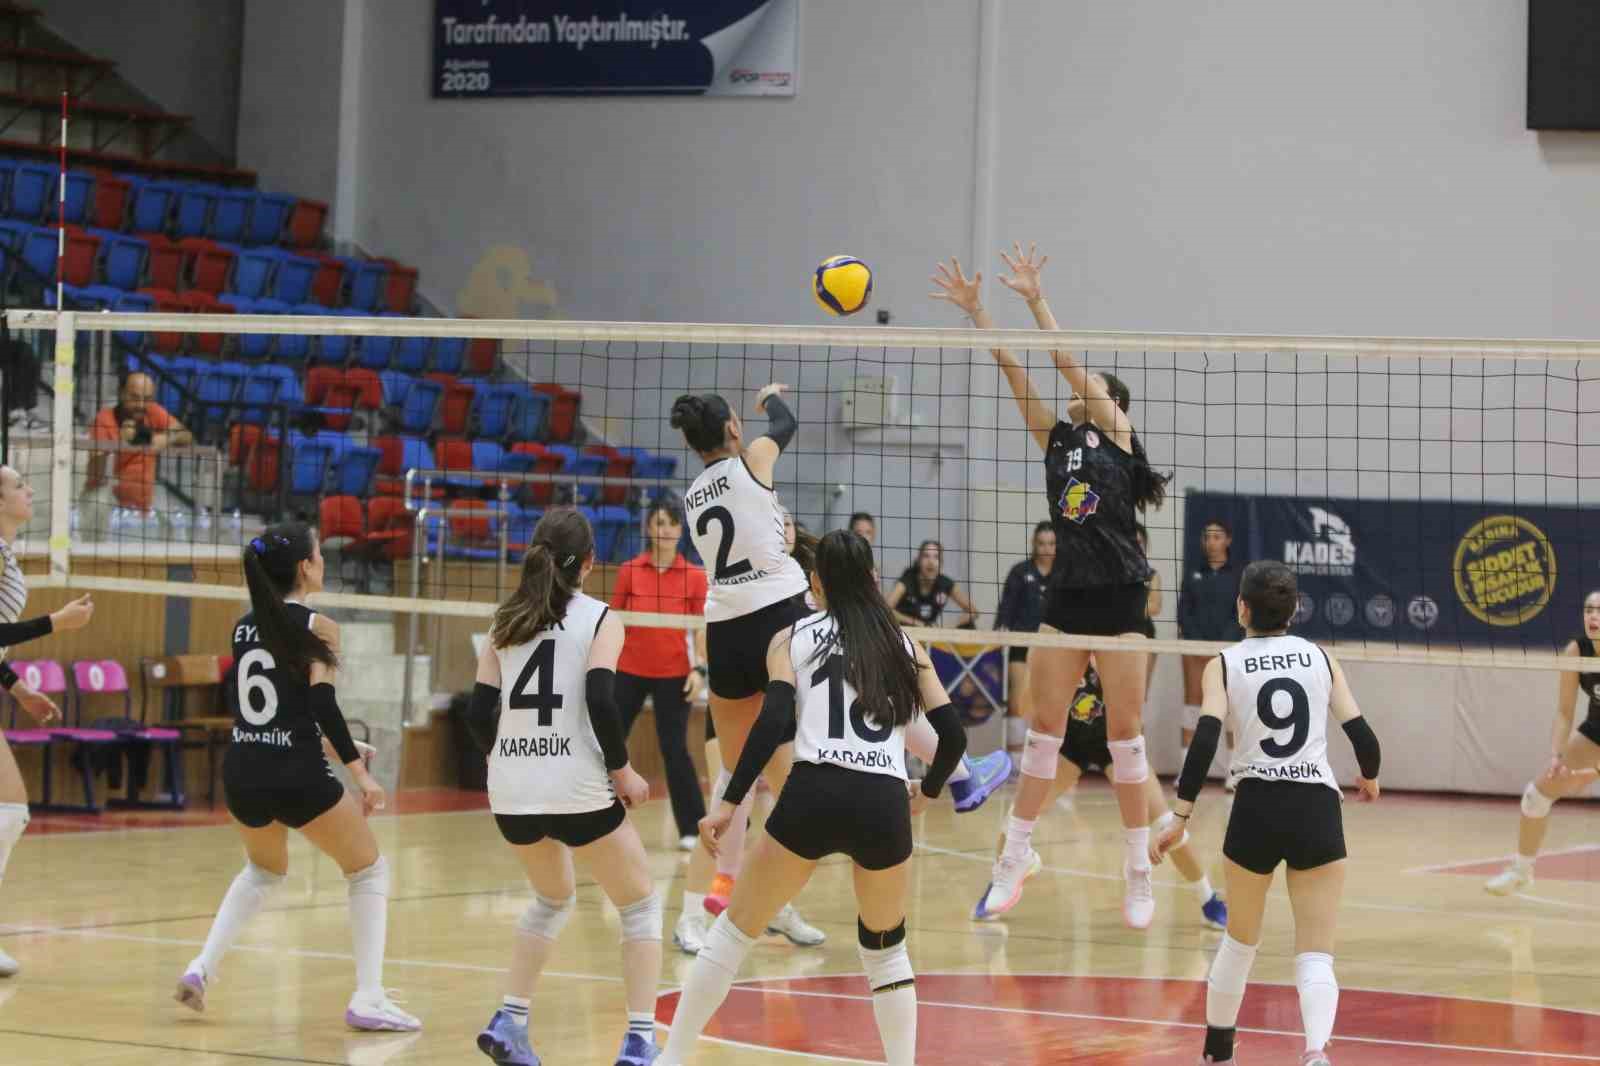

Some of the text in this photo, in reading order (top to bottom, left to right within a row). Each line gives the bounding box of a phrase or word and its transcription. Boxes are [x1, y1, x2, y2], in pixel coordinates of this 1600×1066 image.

[442, 13, 689, 50] Tarafından Yaptırılmıştır.
[442, 72, 490, 91] 2020
[686, 476, 730, 512] NEHİR
[696, 505, 753, 579] 2
[1284, 541, 1355, 565] KADES
[1244, 652, 1312, 674] BERFU
[238, 648, 278, 726] 6
[509, 639, 563, 726] 4
[1257, 677, 1310, 758] 9
[500, 733, 571, 757] KARABÜK
[818, 747, 897, 770] KARABÜK
